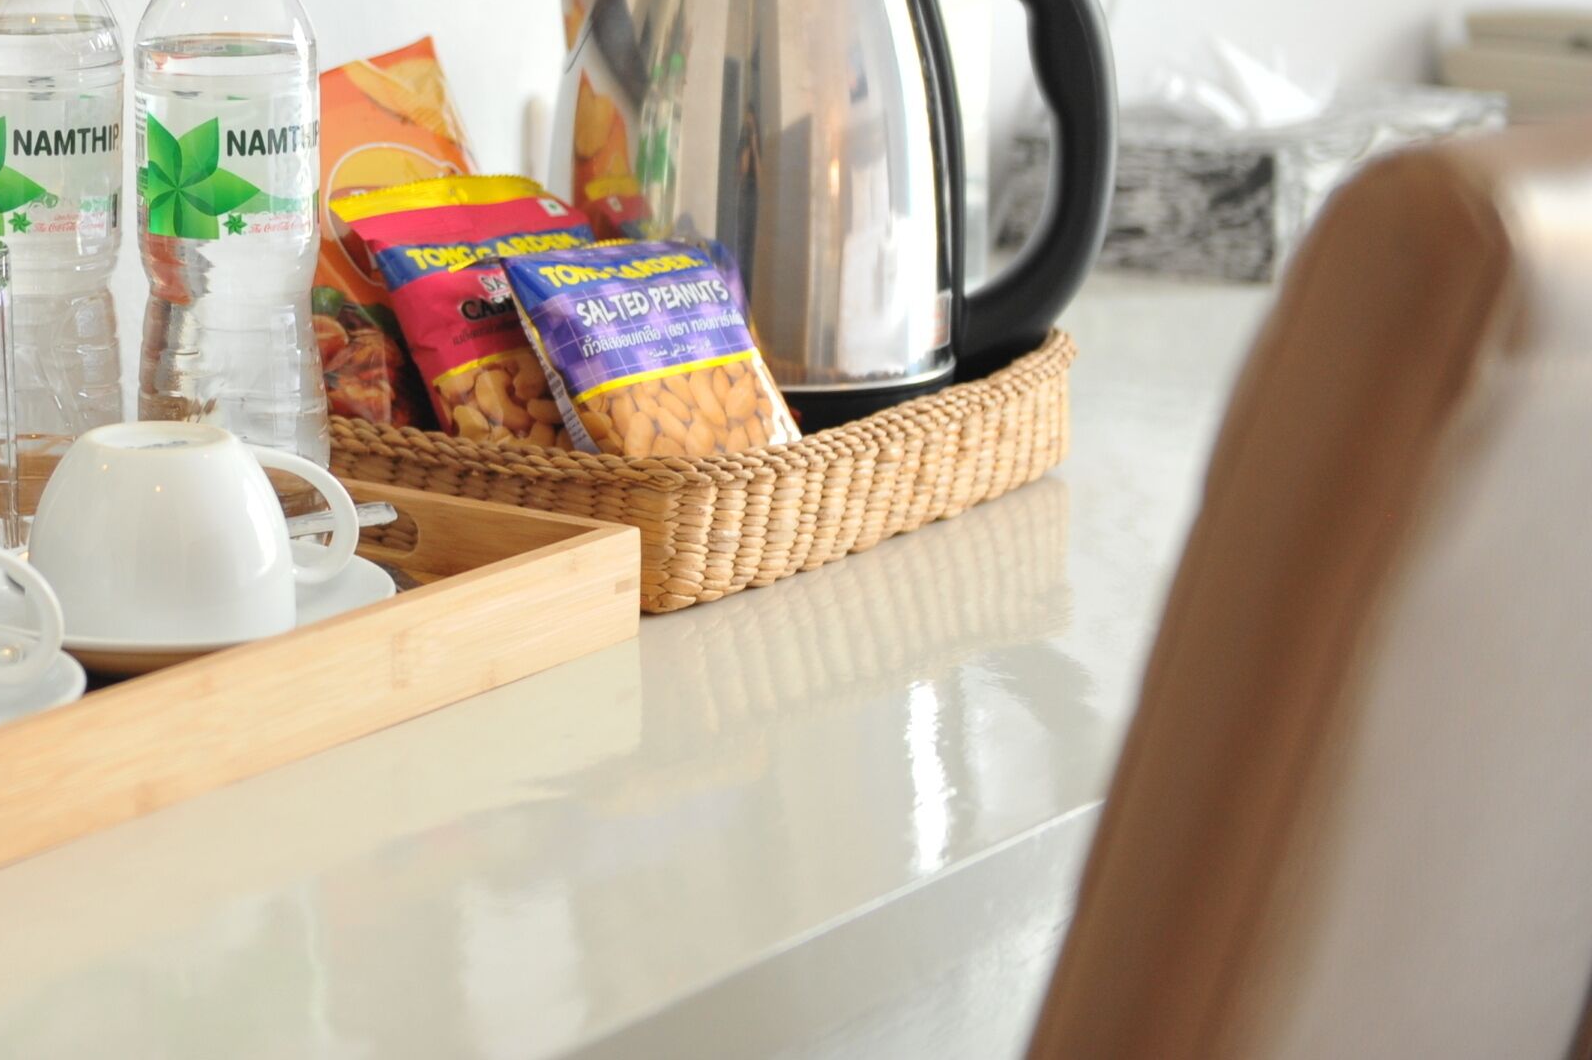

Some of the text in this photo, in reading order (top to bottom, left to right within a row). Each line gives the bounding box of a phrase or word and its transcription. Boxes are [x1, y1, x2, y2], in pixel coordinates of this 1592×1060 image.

[13, 122, 119, 156] NAMTHIP
[575, 279, 729, 328] SALTED PEANUTS
